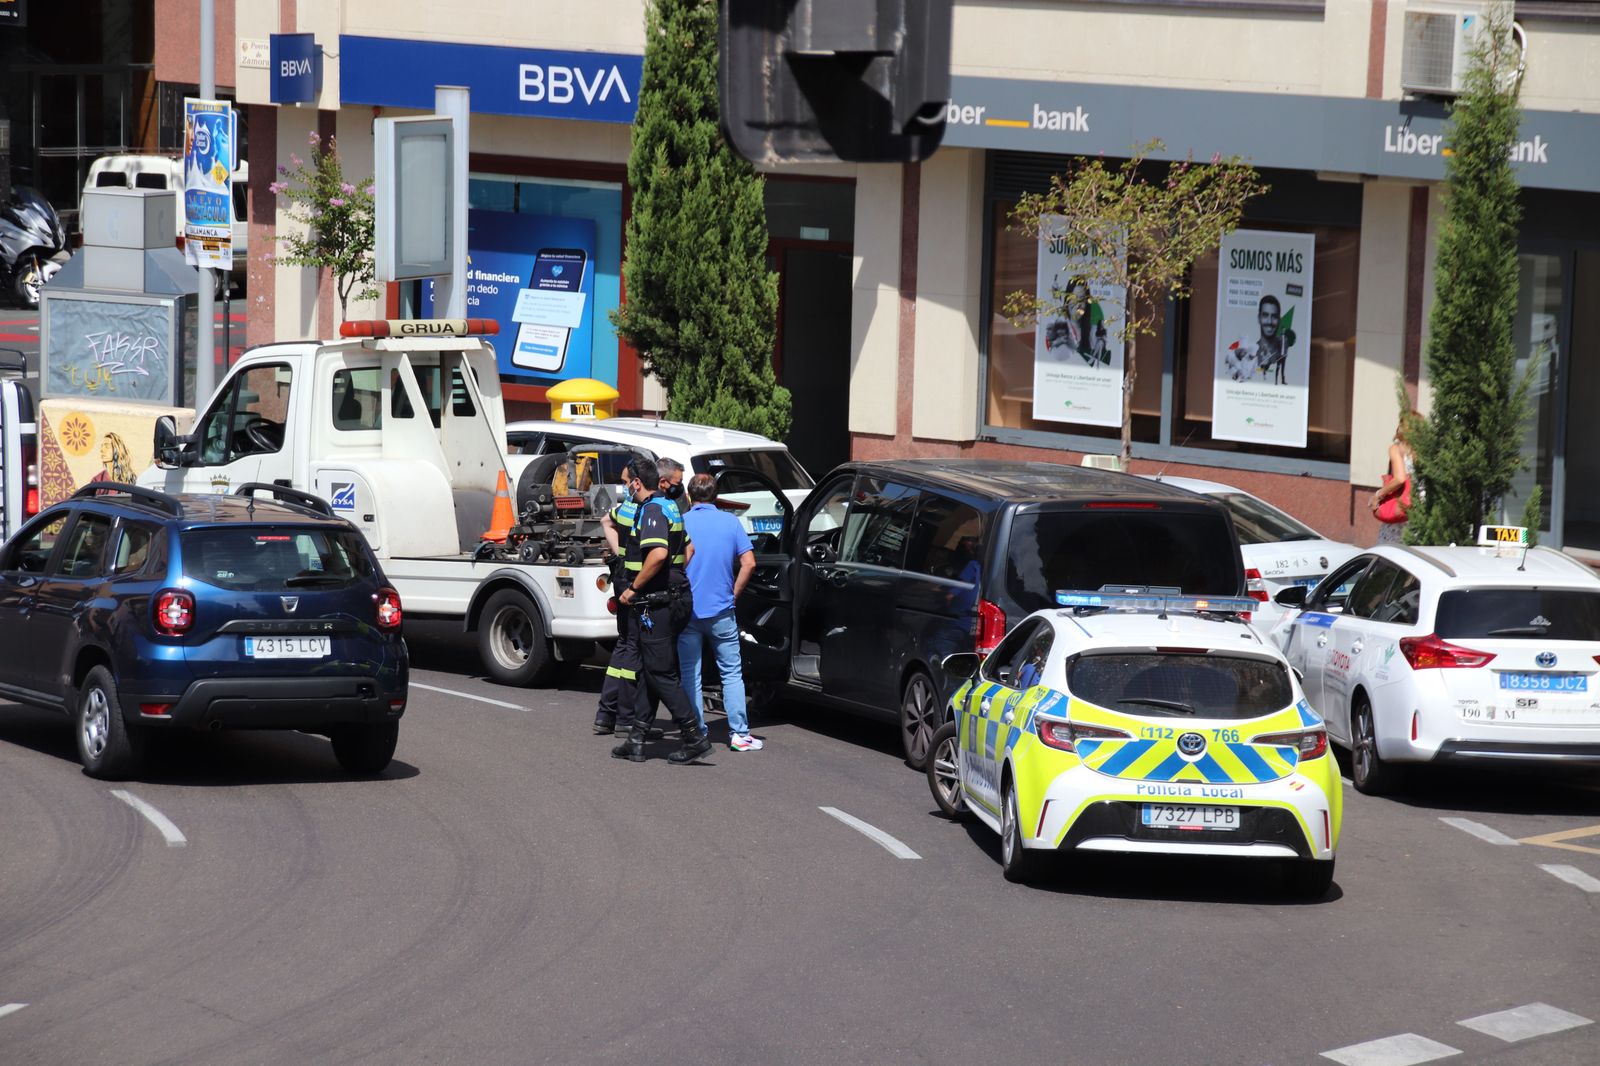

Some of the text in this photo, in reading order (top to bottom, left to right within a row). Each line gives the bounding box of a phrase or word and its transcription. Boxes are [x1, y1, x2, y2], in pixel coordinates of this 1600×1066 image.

[281, 58, 311, 77] BBVA
[519, 64, 631, 105] BBVA
[1033, 103, 1089, 132] bank
[1384, 125, 1442, 156] Liber
[1230, 248, 1303, 274] SOMOS MÁS
[475, 270, 520, 284] financiera
[477, 283, 499, 295] dedo
[401, 323, 455, 334] GRUA
[576, 404, 591, 415] TAXI
[1495, 528, 1520, 542] TAXI
[1275, 559, 1289, 569] 182
[256, 638, 327, 653] 4315 LCV
[1510, 674, 1585, 690] 8358 JCZ
[1516, 699, 1538, 708] SP
[1462, 708, 1516, 719] 190 M
[1146, 727, 1174, 739] 112
[1212, 729, 1240, 742] 766
[1202, 787, 1244, 799] Local
[1154, 806, 1235, 824] 7327 LPB
